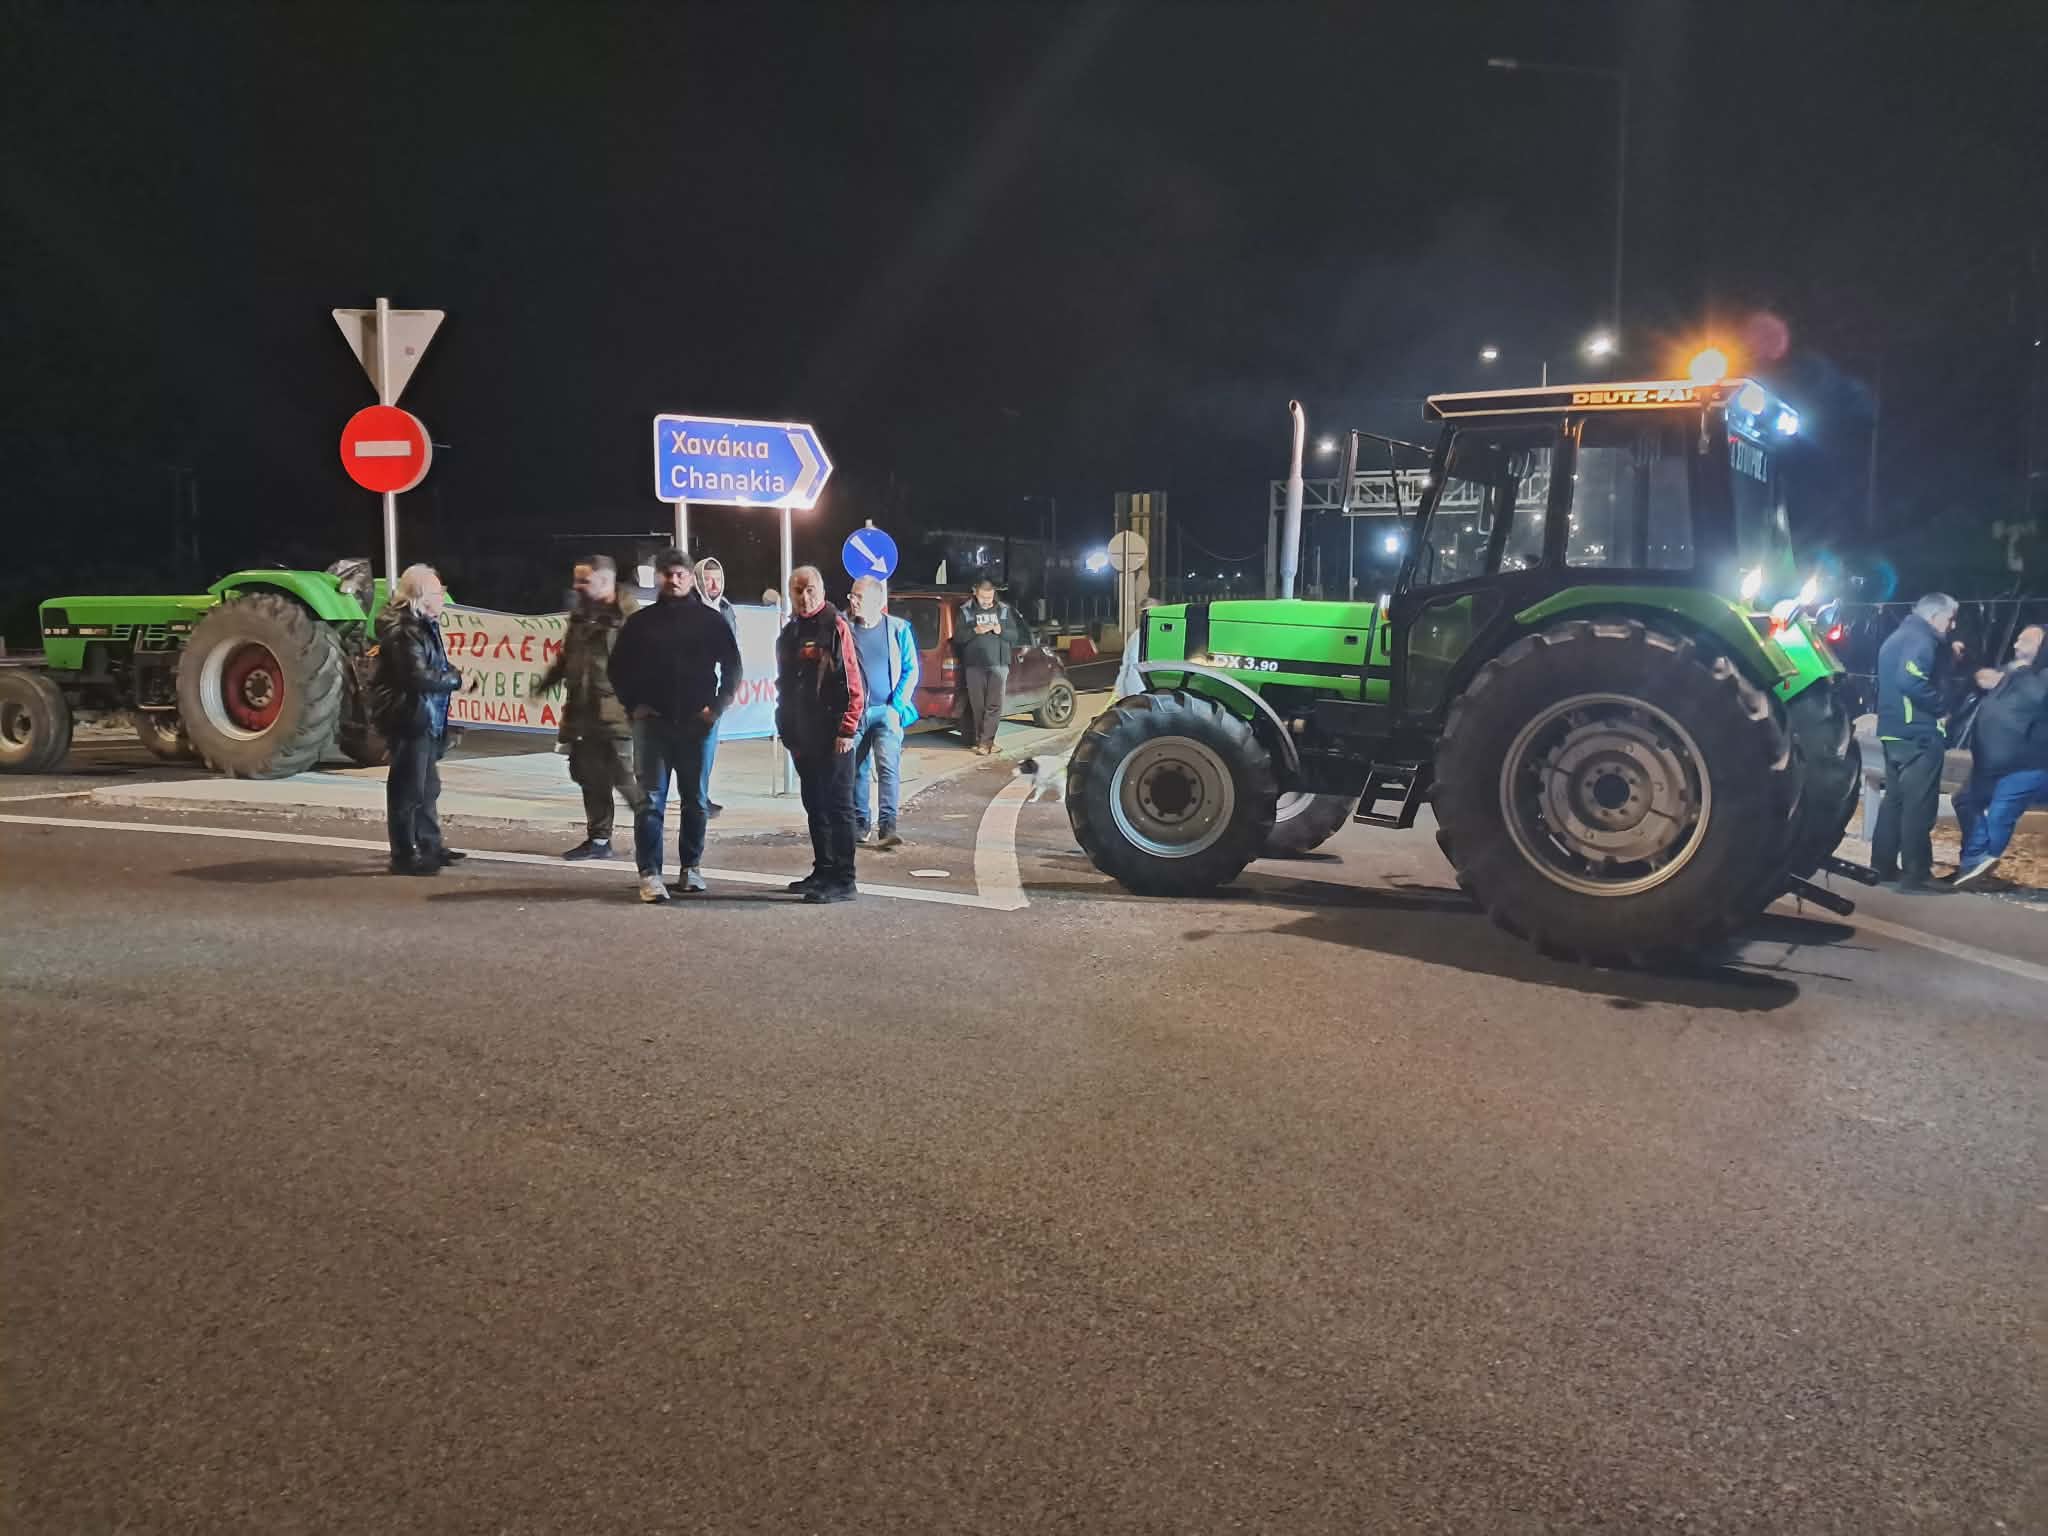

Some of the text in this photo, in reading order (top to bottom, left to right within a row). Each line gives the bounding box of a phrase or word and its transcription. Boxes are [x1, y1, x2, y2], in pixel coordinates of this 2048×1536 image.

[671, 430, 769, 459] Χανάκια
[671, 464, 785, 493] Chanakia
[1244, 656, 1279, 671] 3.90
